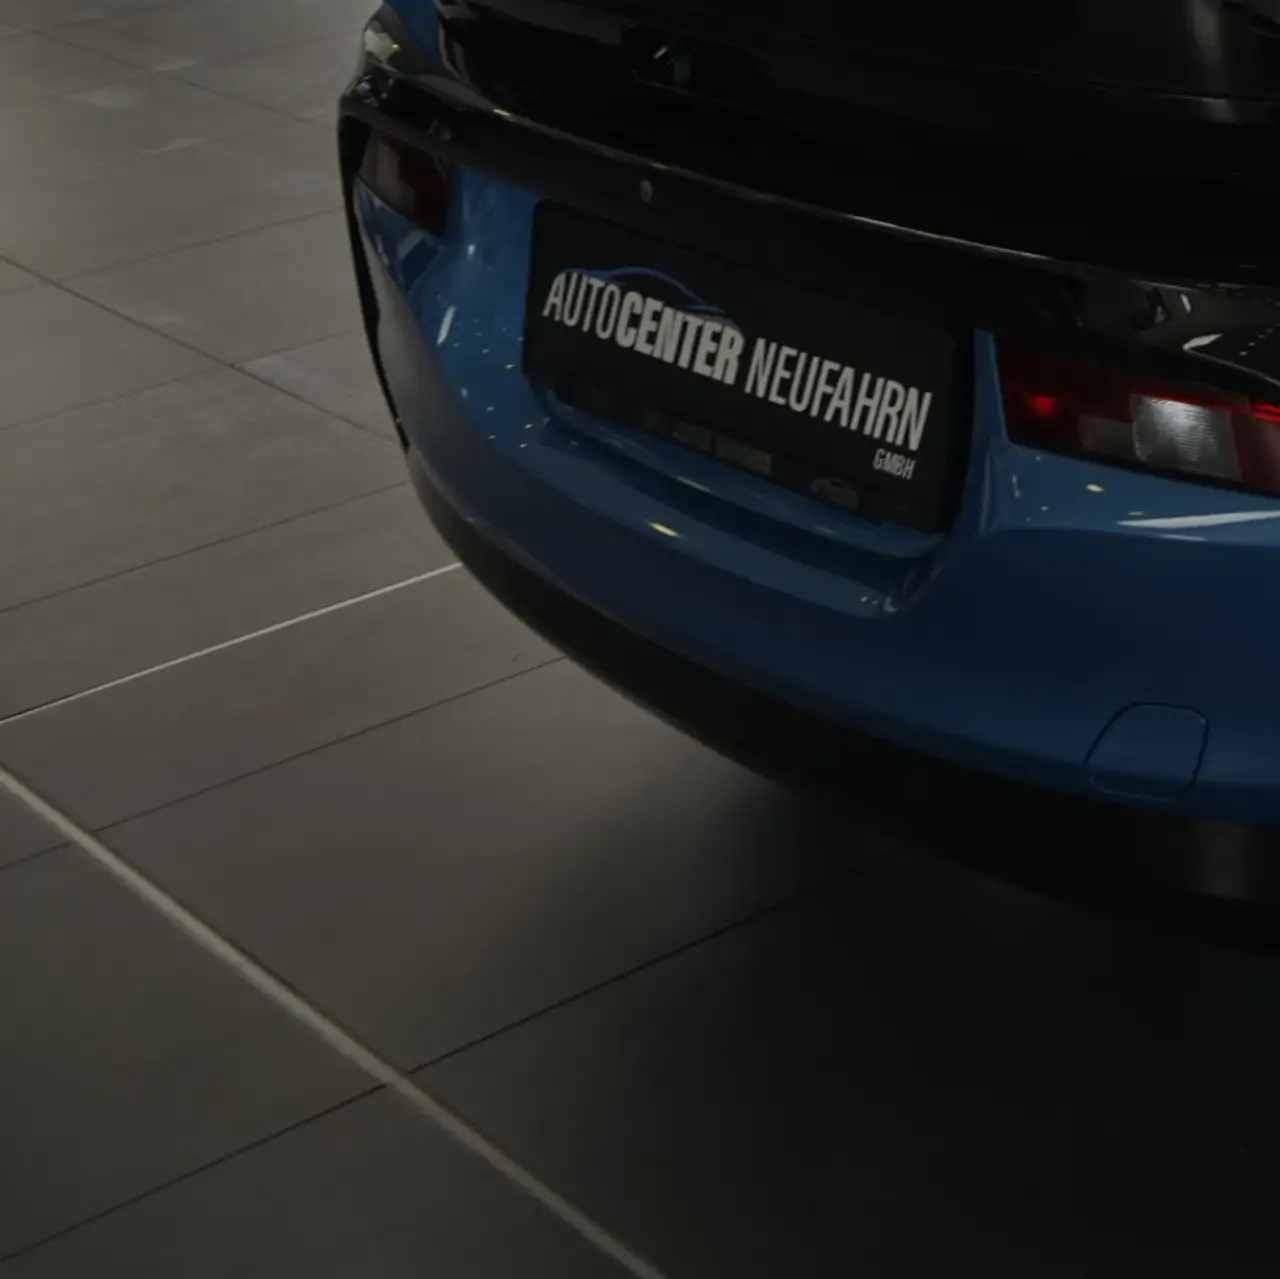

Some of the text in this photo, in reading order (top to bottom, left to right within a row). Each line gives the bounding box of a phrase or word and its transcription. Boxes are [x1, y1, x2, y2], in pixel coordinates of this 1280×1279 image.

[544, 272, 745, 385] AUTOCENTER
[745, 338, 932, 451] NEUFAHRN
[873, 448, 916, 481] GMBH
